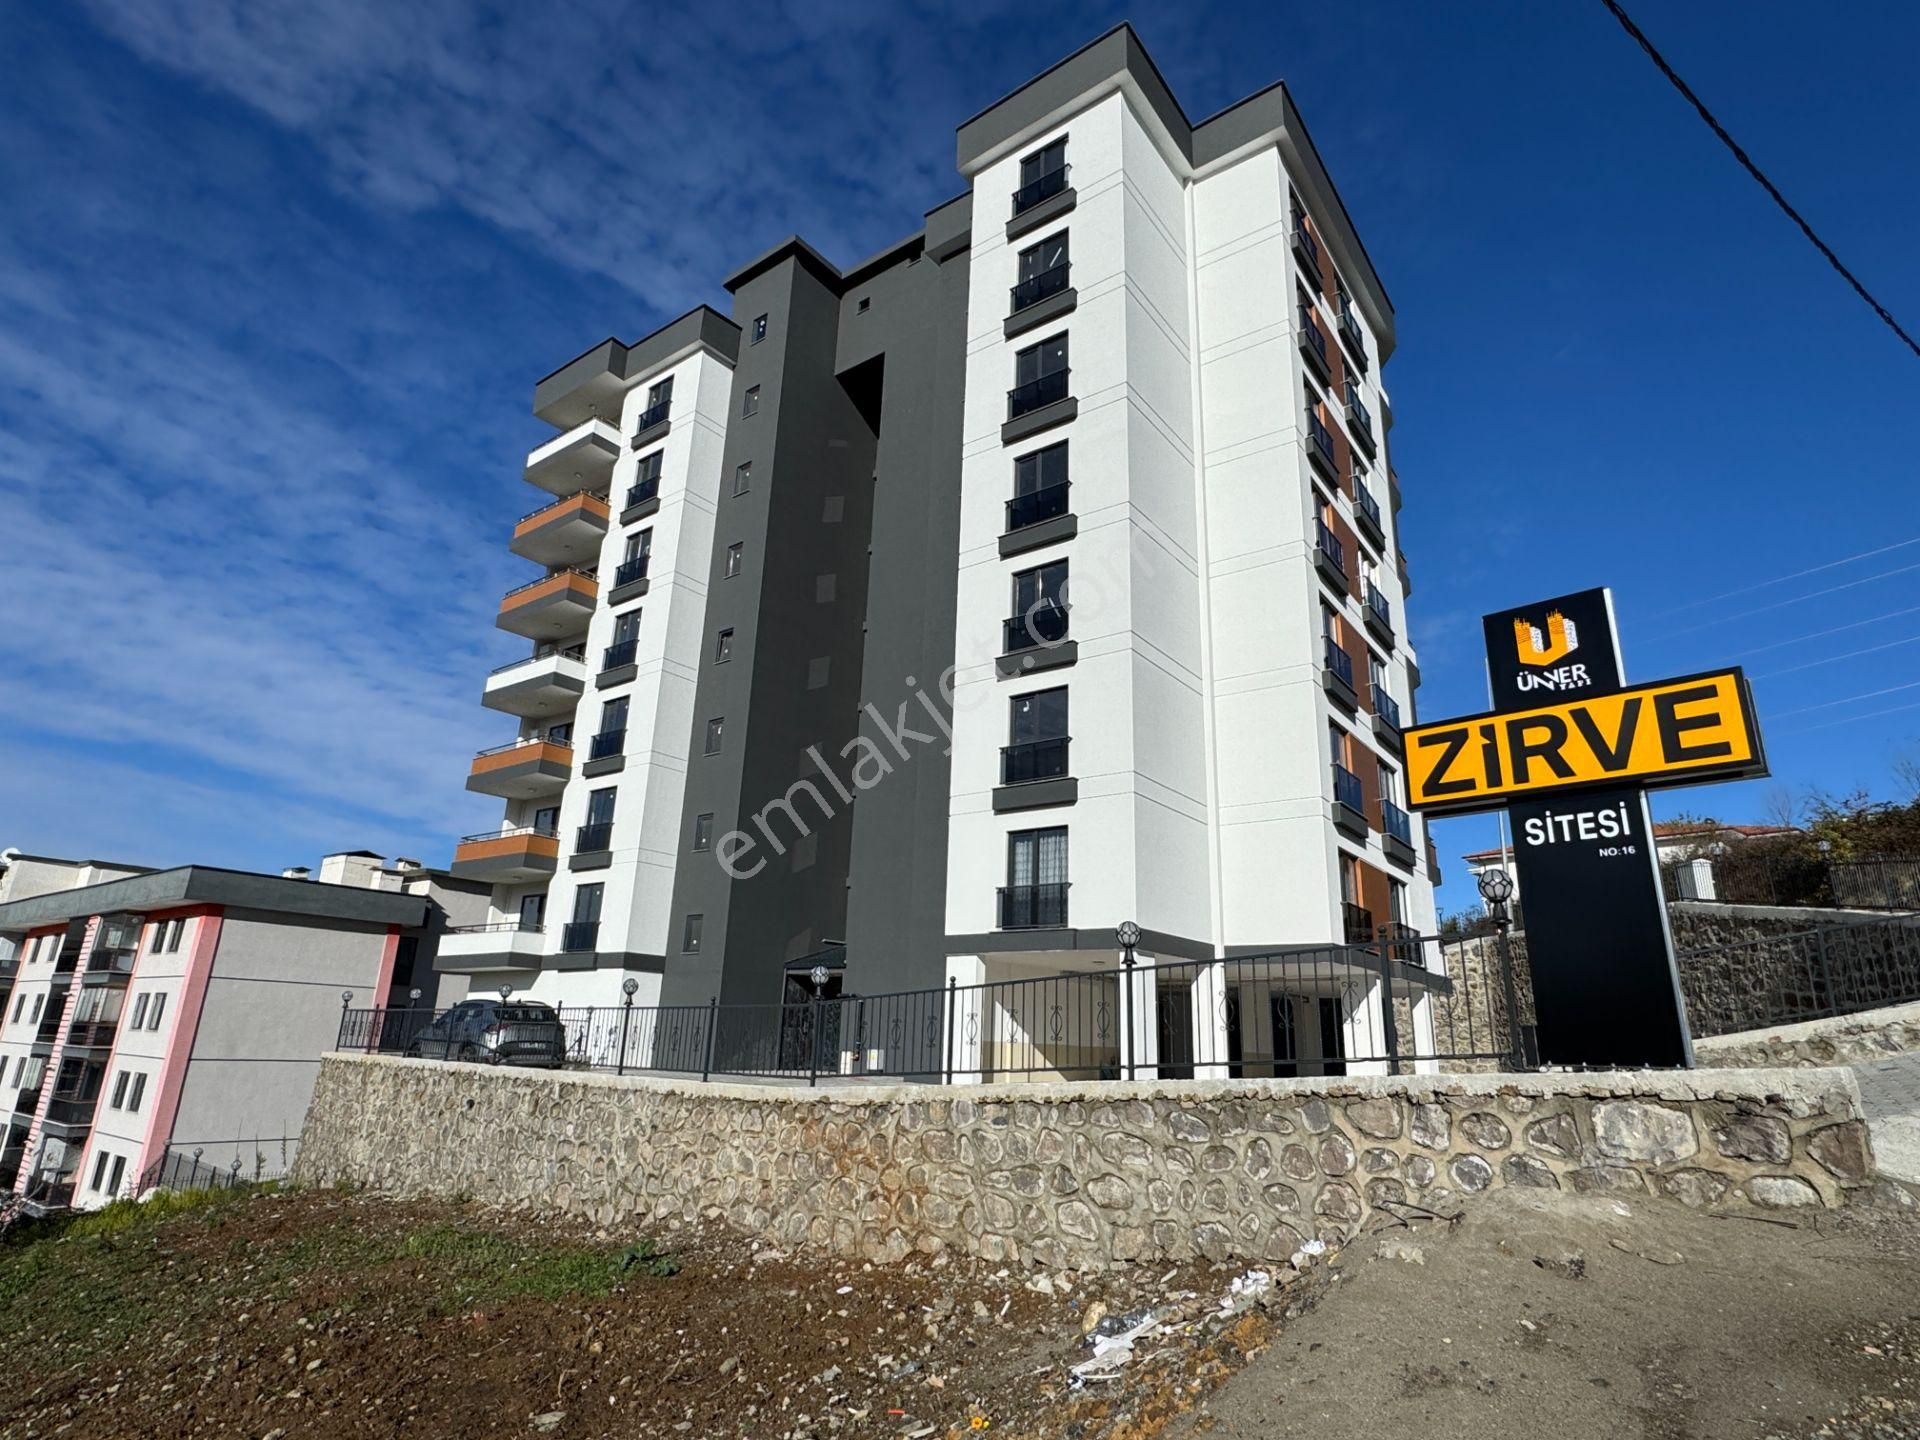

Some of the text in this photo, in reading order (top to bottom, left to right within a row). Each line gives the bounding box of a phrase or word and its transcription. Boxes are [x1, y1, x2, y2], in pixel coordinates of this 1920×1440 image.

[1516, 663, 1590, 691] ÜNVER
[1417, 684, 1733, 798] ZİRVE
[1524, 801, 1631, 846] SİTESİ
[1599, 845, 1636, 857] NO:16
